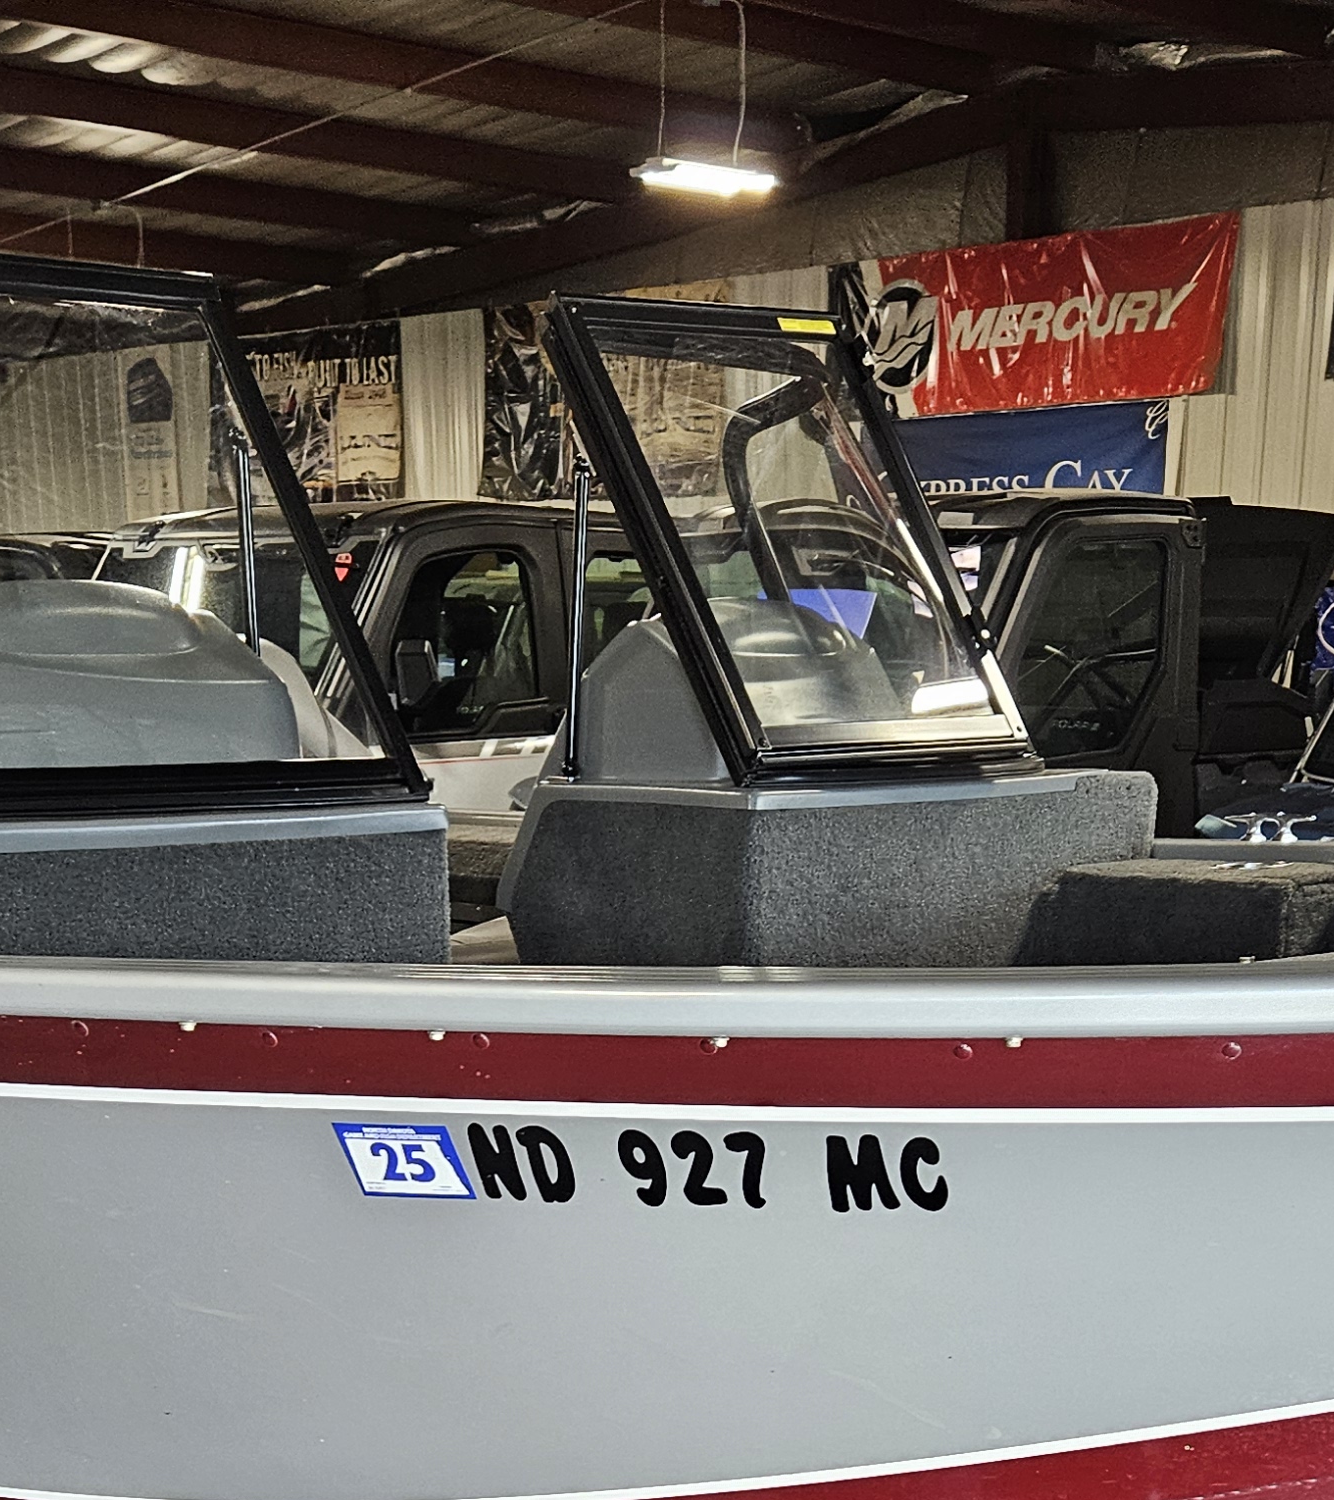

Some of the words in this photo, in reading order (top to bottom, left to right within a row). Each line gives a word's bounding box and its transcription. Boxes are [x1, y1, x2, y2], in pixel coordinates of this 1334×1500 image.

[949, 281, 1197, 352] MERCURY
[362, 354, 399, 385] LAST
[1044, 459, 1134, 491] CAY
[370, 1141, 436, 1183] 25
[467, 1122, 576, 1203] ND
[617, 1128, 768, 1209] 927
[826, 1133, 949, 1213] MC
